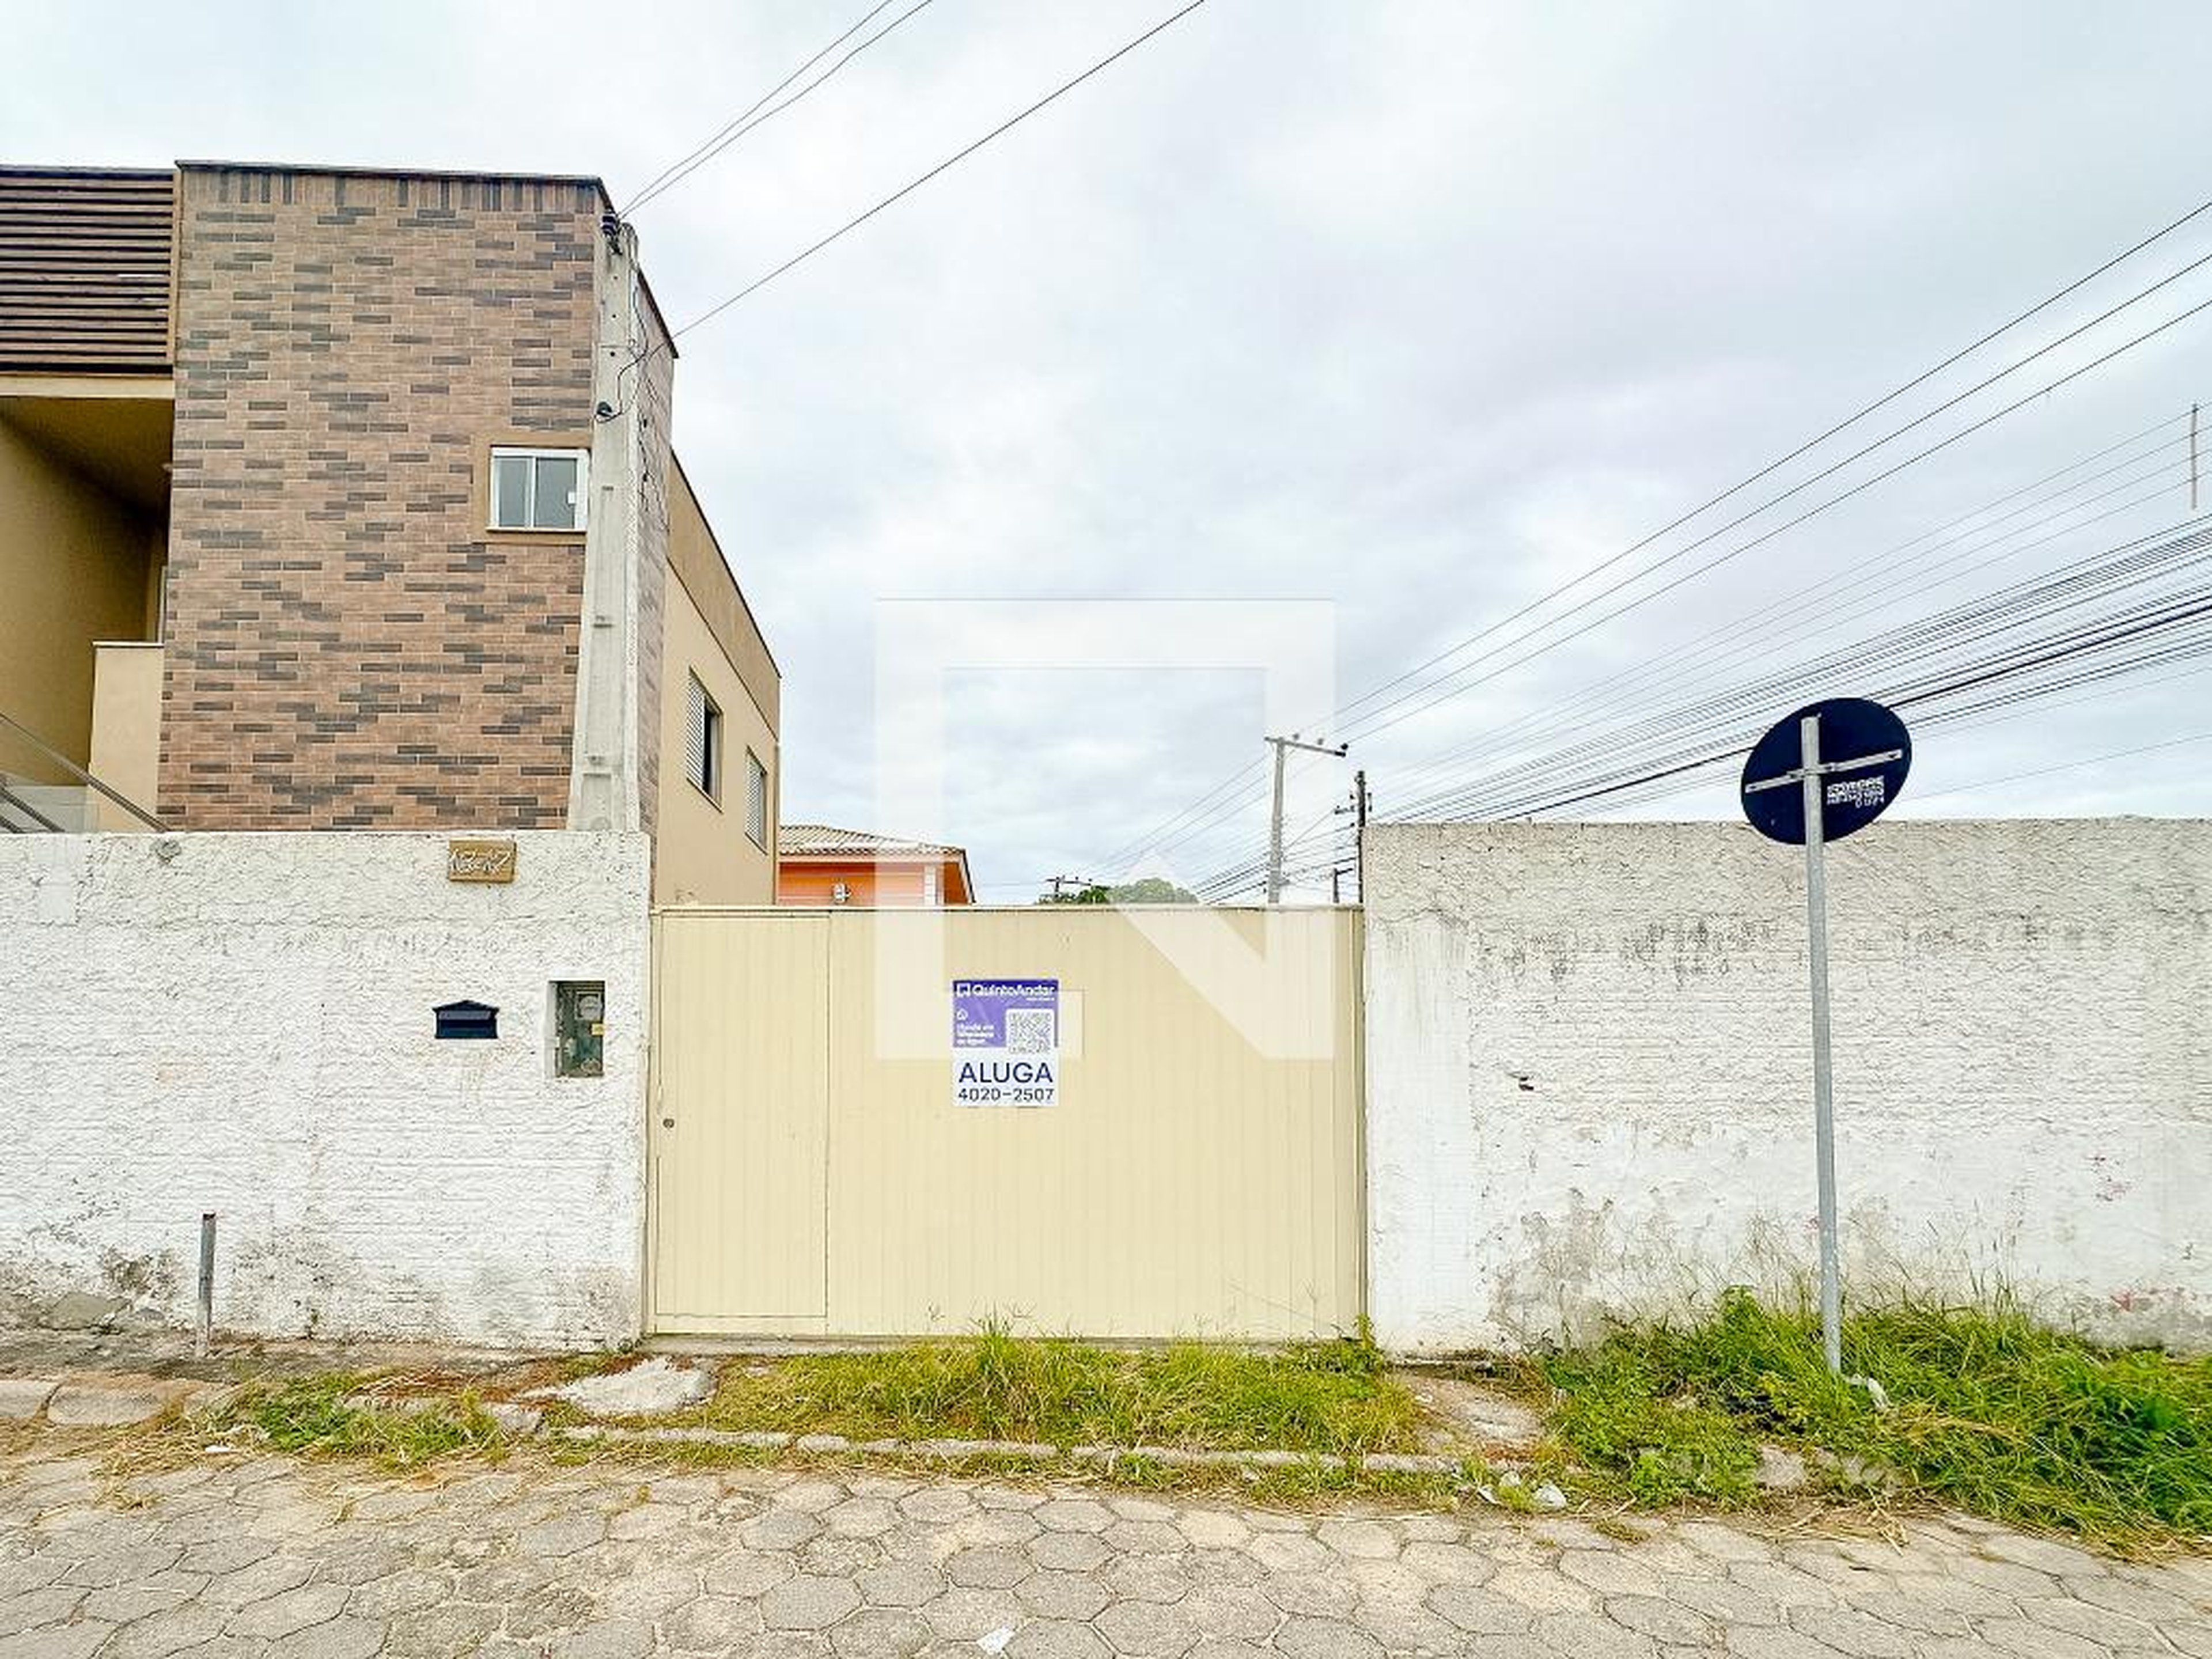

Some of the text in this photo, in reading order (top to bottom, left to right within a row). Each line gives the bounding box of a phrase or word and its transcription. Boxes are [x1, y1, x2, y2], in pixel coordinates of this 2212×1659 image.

[972, 984, 1055, 996] QuintoAndar
[959, 1062, 1053, 1083] ALUGA
[958, 1088, 1054, 1101] 4020-2507
